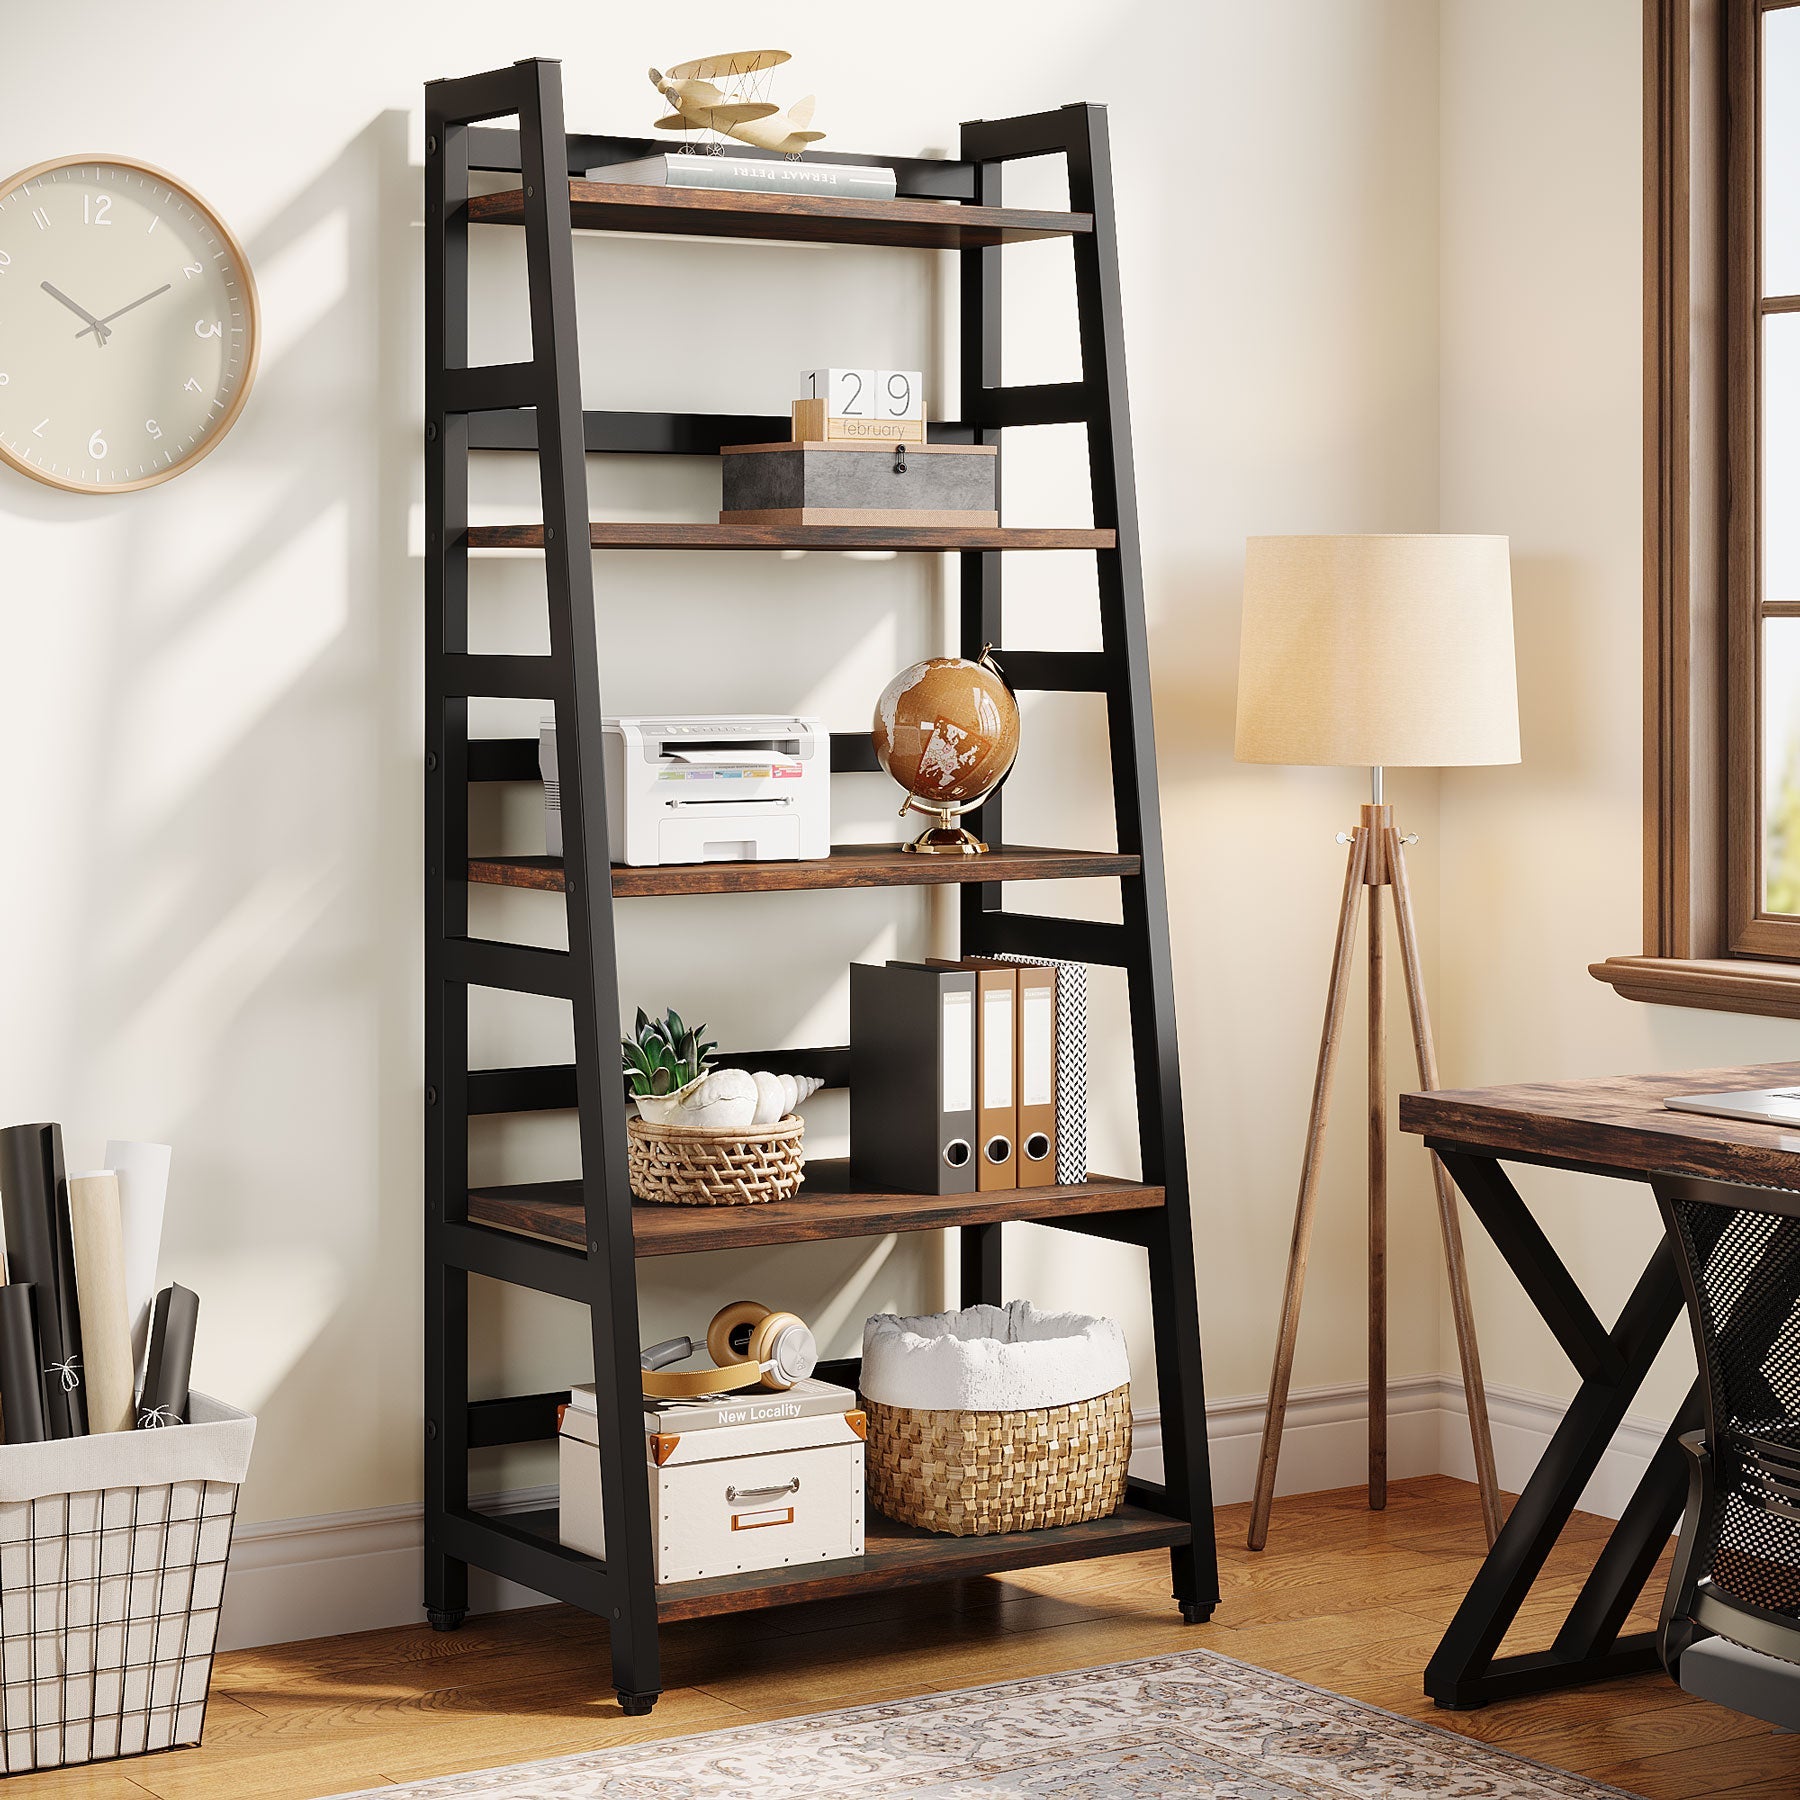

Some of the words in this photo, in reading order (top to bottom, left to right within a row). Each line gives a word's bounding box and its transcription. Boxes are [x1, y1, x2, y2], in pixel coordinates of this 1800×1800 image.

[733, 167, 776, 180] PETRI
[781, 170, 837, 185] FERMAT
[83, 195, 112, 225] 12
[182, 262, 203, 280] 2
[194, 319, 223, 339] 3
[183, 377, 203, 393] 4
[808, 372, 816, 399] 1
[32, 418, 49, 438] 7
[145, 420, 163, 440] 5
[842, 419, 905, 441] february
[88, 428, 108, 460] 6
[718, 1410, 747, 1424] New
[750, 1403, 801, 1420] Locality
